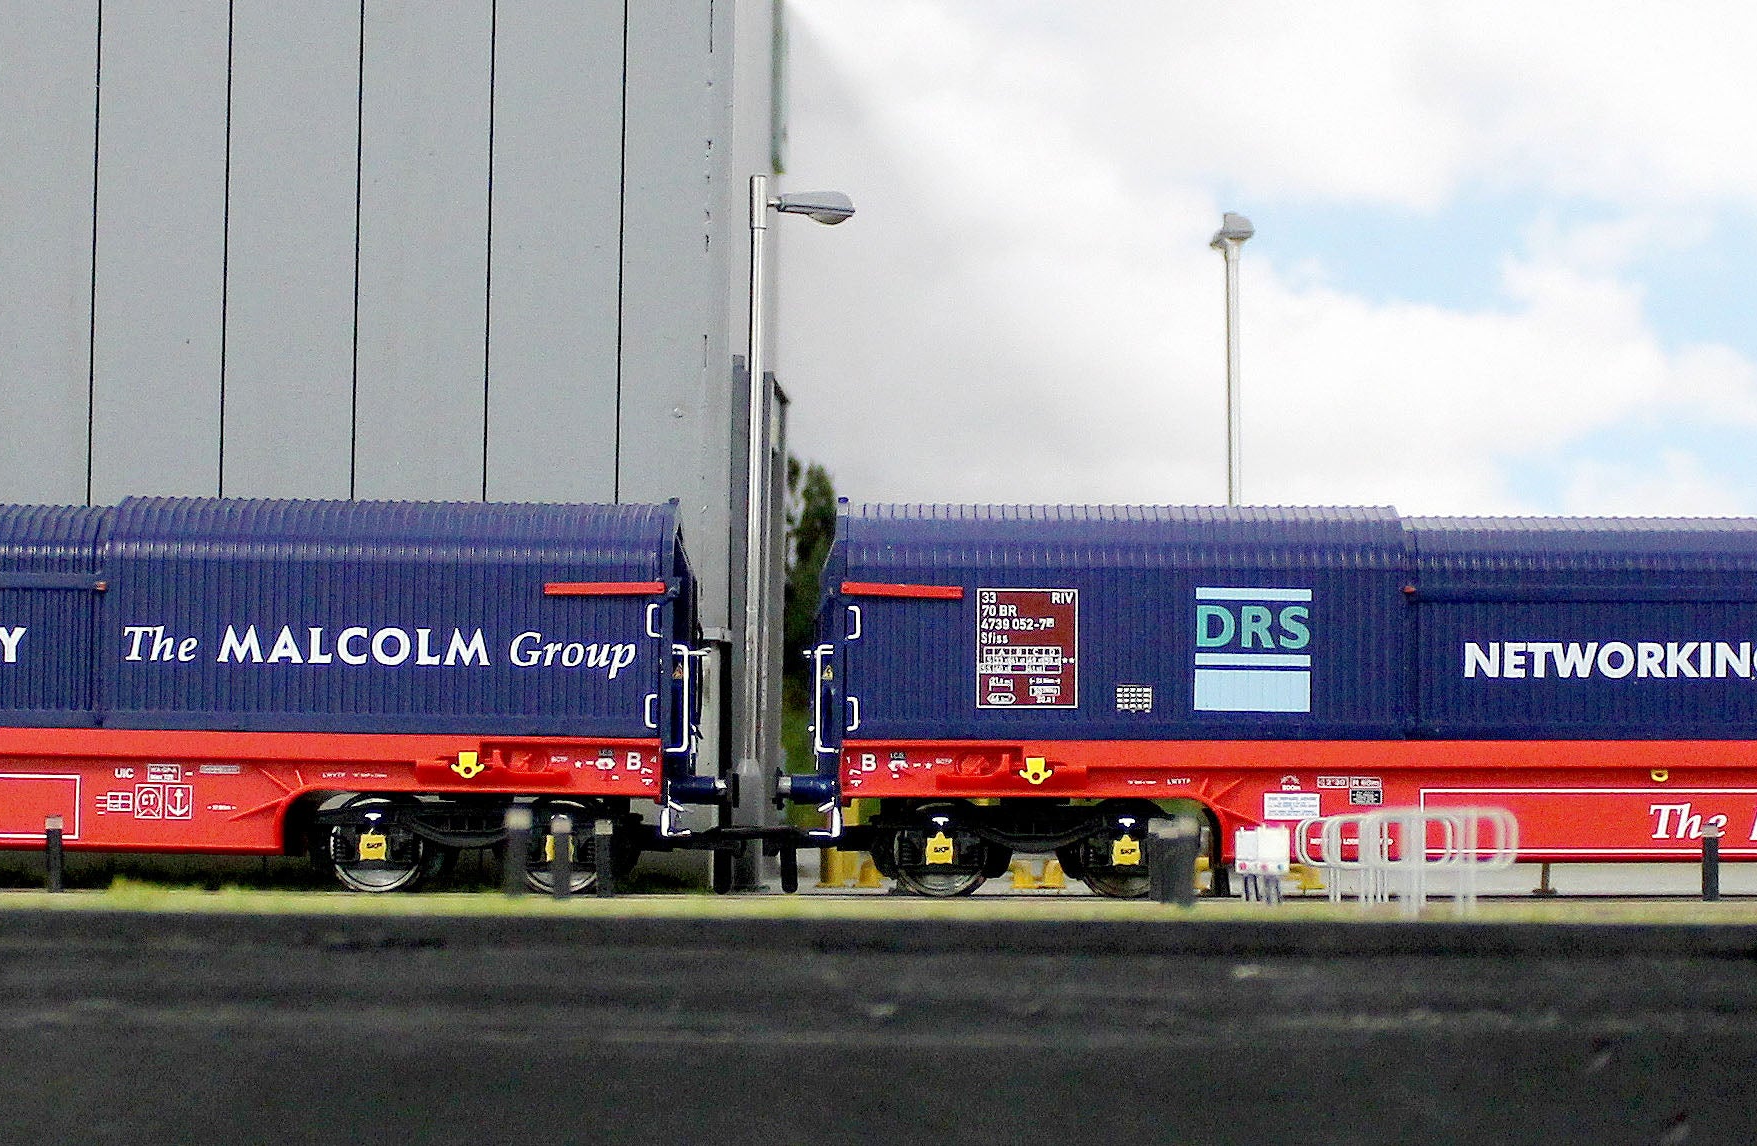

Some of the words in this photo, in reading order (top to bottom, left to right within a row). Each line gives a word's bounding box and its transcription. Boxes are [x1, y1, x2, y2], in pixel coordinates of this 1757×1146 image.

[981, 592, 997, 604] 33
[1051, 592, 1073, 604] RIV
[981, 605, 997, 617] 70
[999, 605, 1017, 617] BR
[981, 618, 1010, 630] 4739
[1197, 605, 1311, 649] DRS
[124, 625, 198, 663] The
[217, 625, 491, 667] MALCOLM
[510, 631, 637, 680] Group
[626, 751, 641, 770] B
[861, 753, 877, 772] B
[114, 767, 135, 779] UIC
[1649, 802, 1729, 840] The
